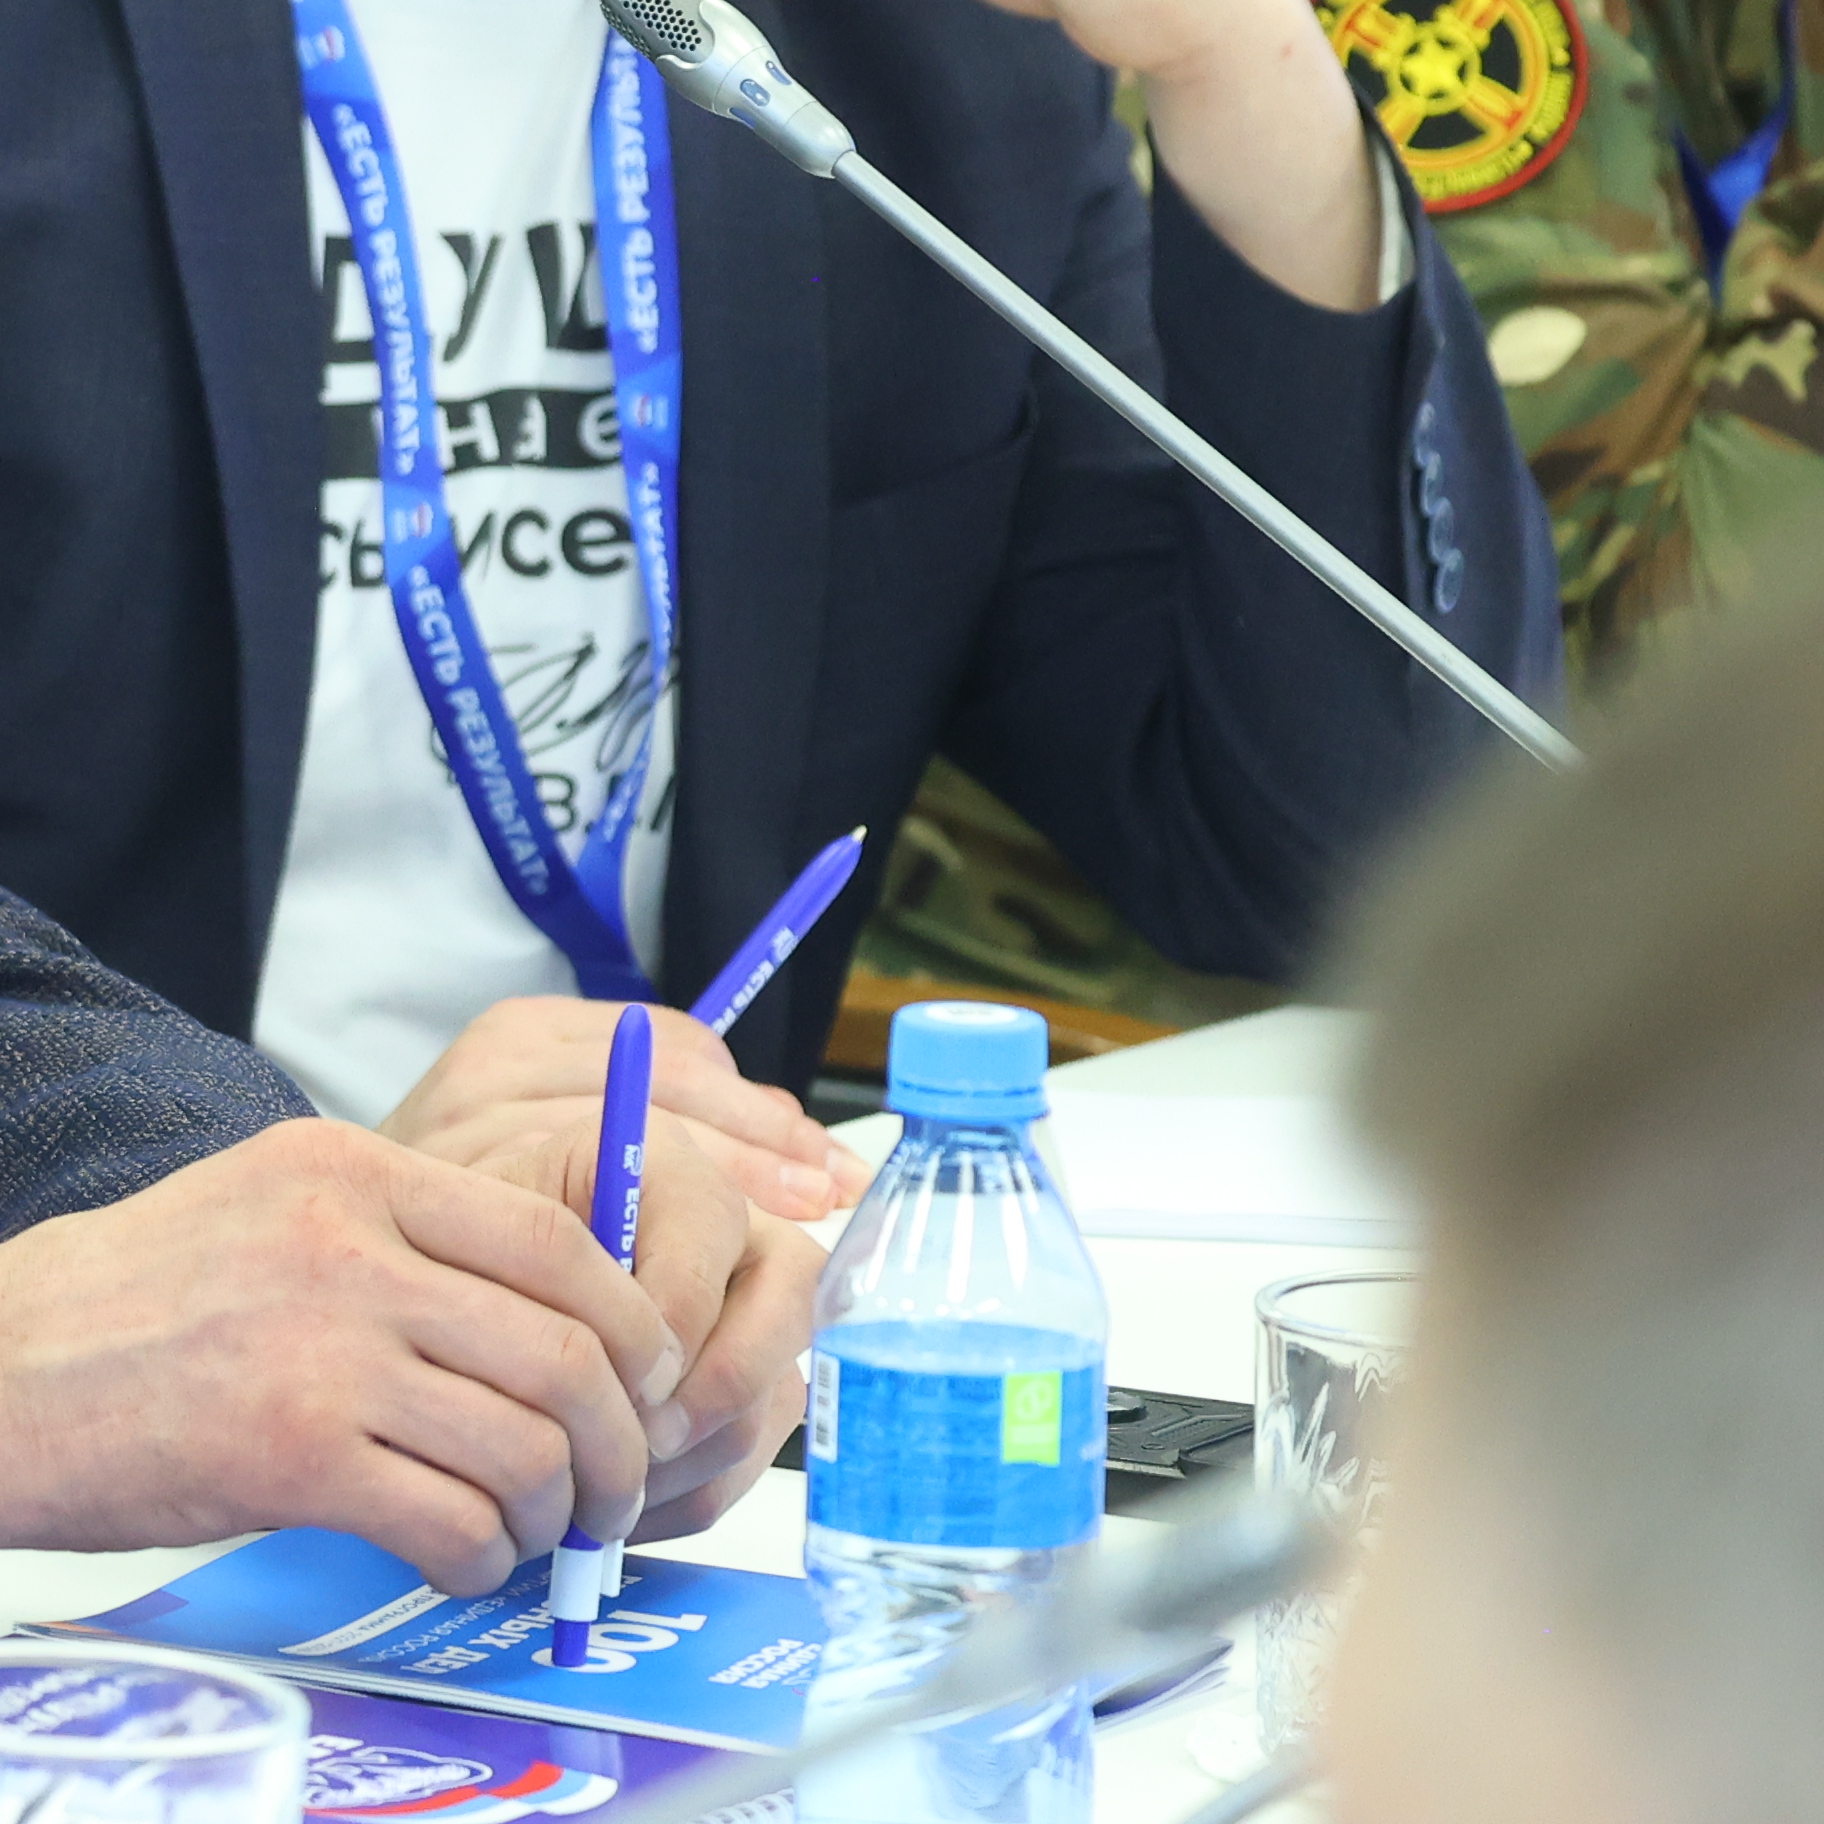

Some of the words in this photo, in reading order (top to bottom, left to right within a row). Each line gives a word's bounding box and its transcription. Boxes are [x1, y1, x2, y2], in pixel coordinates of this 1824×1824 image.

[332, 102, 389, 227] «ЕСТЬ
[368, 227, 421, 476] РЕЗУЛЬТАТ»
[408, 564, 464, 686] «ЕСТЬ
[620, 1186, 640, 1254] ЕСТЬ
[399, 1645, 490, 1674] ДЕЛ
[707, 1637, 805, 1684] РОССИЯ
